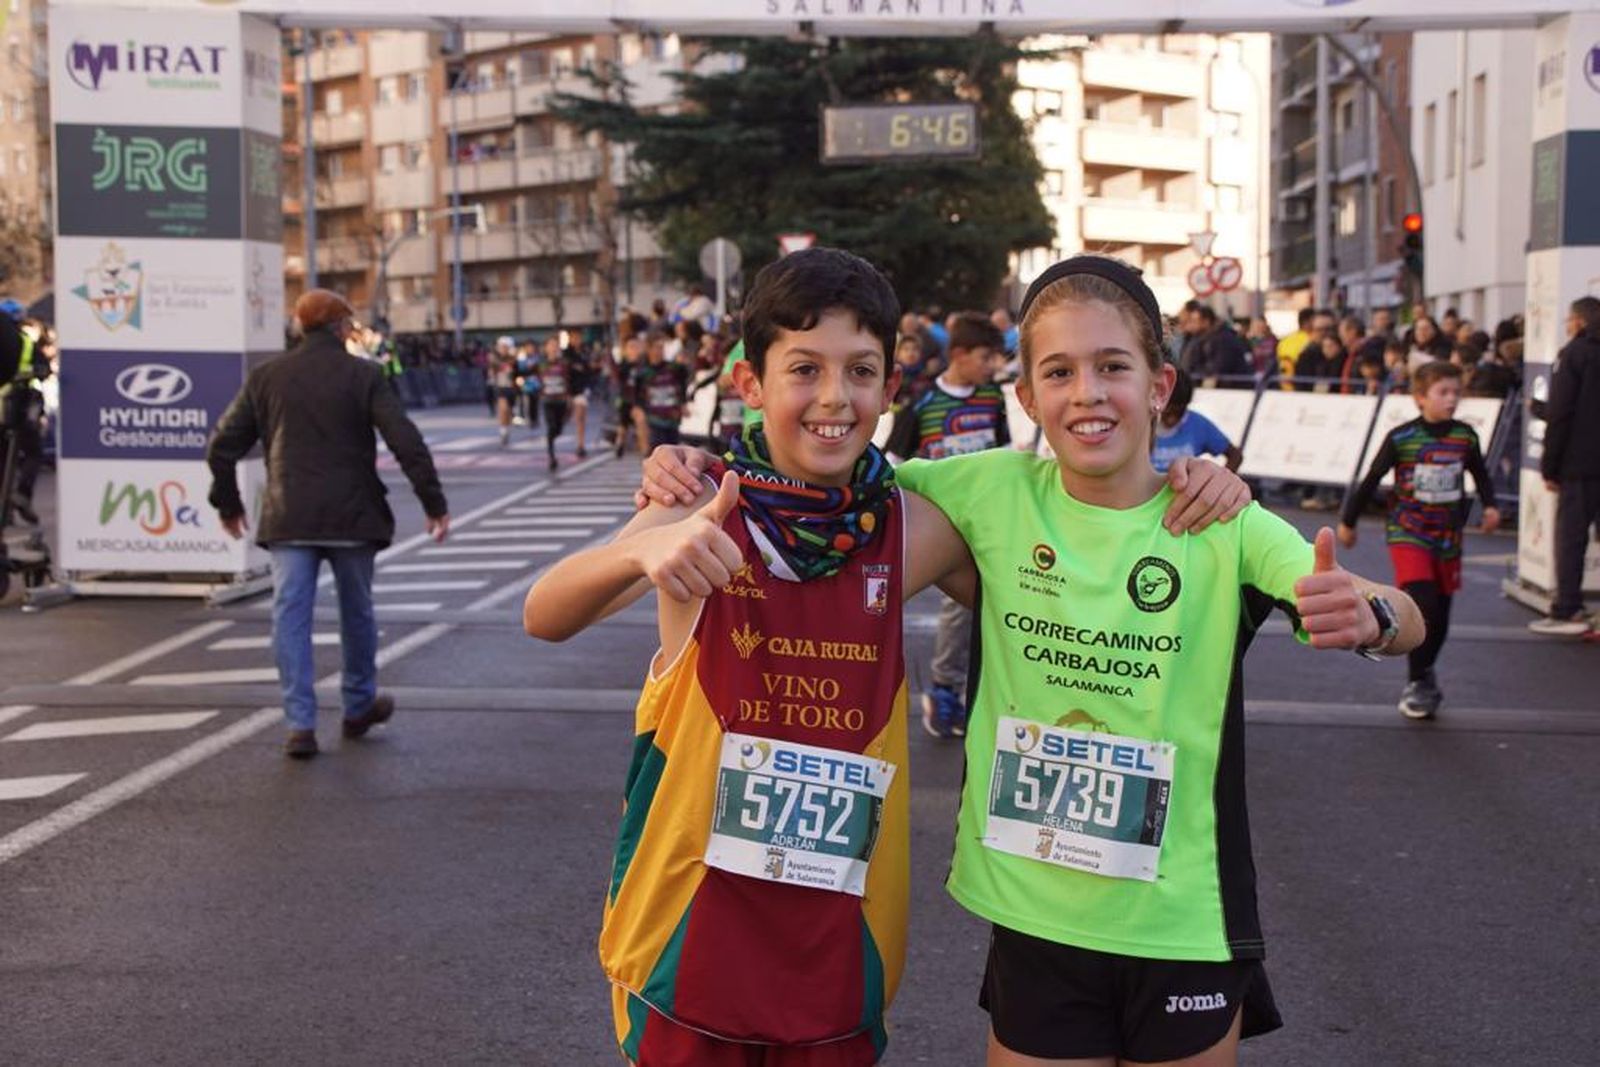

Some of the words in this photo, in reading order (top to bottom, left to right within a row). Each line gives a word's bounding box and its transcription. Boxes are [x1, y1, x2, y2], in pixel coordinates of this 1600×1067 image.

[889, 114, 969, 148] 6:46
[91, 133, 208, 193] JRG
[100, 407, 208, 428] HYUNDAI
[100, 428, 207, 448] Gestorauto
[768, 637, 818, 657] CAJA
[820, 641, 878, 662] RURAL
[1004, 612, 1183, 653] CORRECAMINOS
[1023, 644, 1161, 680] CARBAJOSA
[762, 672, 840, 701] VINO
[1046, 674, 1134, 697] SALAMANCA
[739, 698, 771, 723] DE
[779, 702, 865, 731] TORO
[772, 749, 876, 789] SETEL
[1041, 733, 1155, 772] SETEL
[740, 774, 856, 845] 5752
[1014, 757, 1125, 828] 5739
[1043, 815, 1084, 833] HELENA
